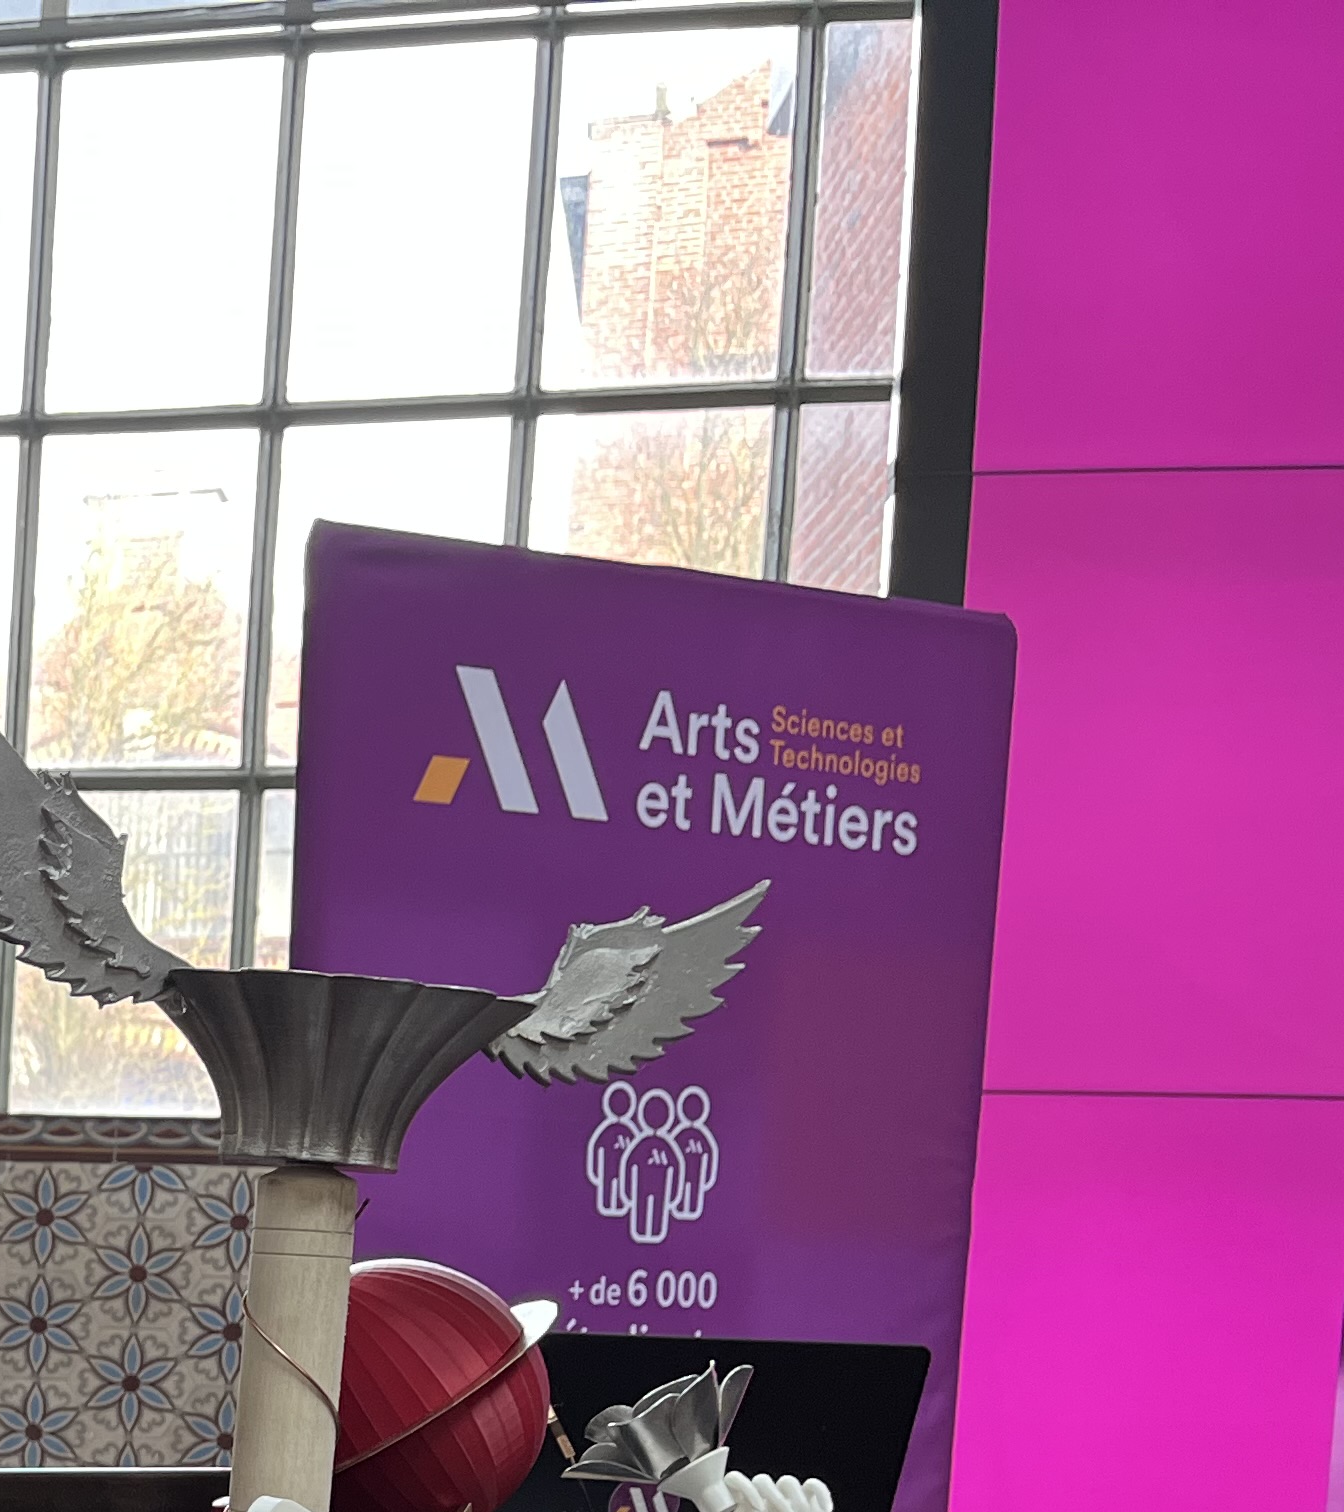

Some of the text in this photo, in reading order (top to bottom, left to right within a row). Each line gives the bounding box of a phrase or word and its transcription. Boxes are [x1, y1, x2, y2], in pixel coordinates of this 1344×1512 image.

[638, 689, 761, 764] Arts
[770, 704, 905, 749] Sciences et
[768, 738, 922, 787] Technologies
[635, 772, 919, 857] et Métiers
[568, 1268, 718, 1309] + de 6 000
